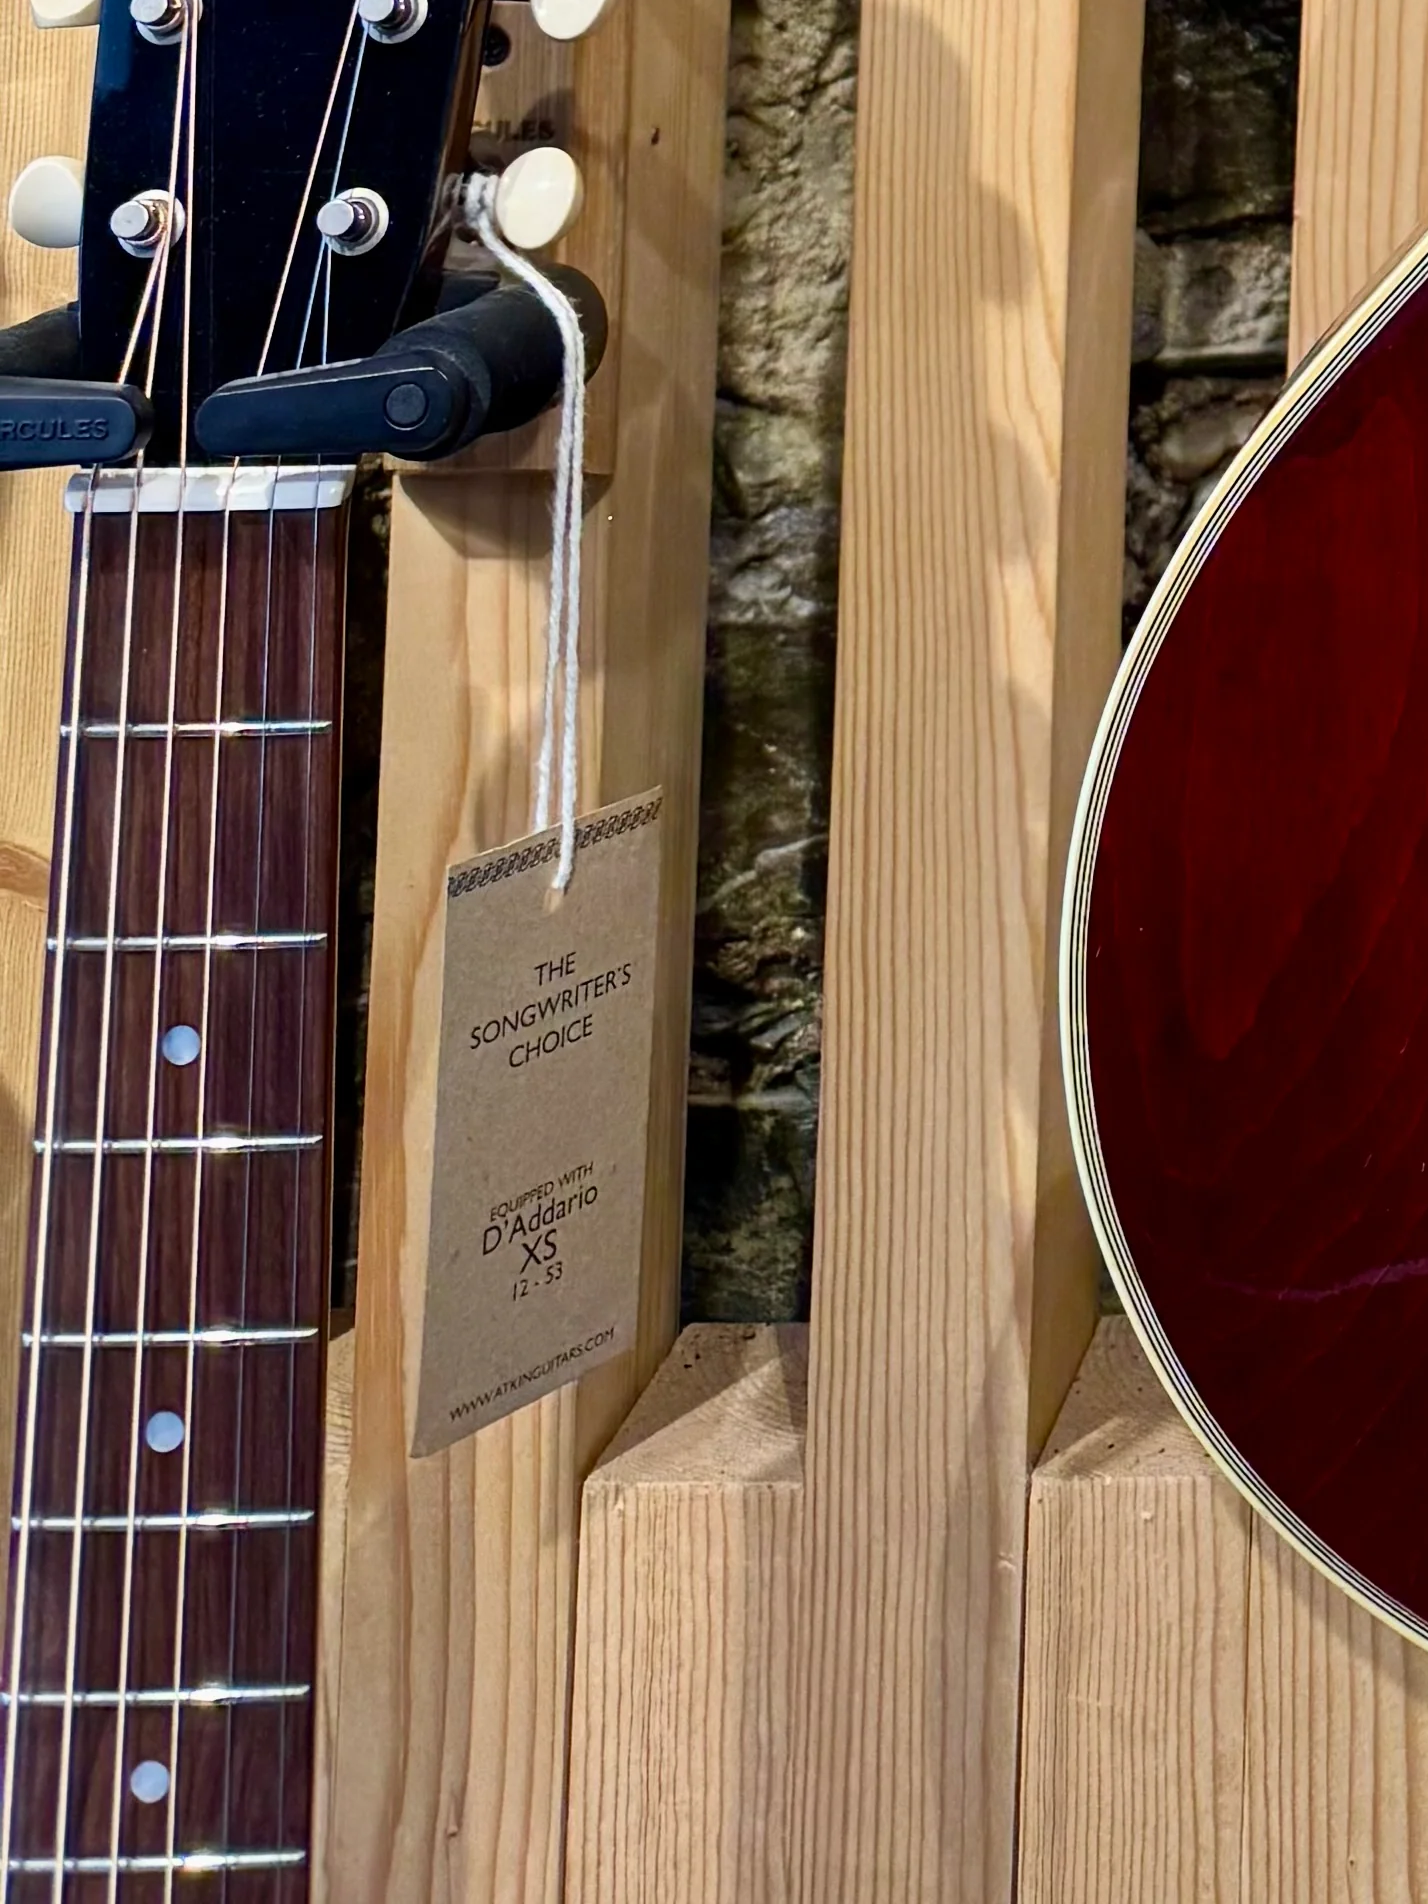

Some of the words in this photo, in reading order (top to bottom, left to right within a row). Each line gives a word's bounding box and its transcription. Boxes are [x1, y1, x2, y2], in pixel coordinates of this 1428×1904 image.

[534, 951, 577, 986] THE
[470, 963, 632, 1050] SONGWRITER'S
[509, 1013, 593, 1068] CHOICE
[490, 1181, 554, 1223] EQUIPPED
[558, 1161, 594, 1189] WITH
[483, 1185, 598, 1256] D'Addario
[520, 1228, 557, 1275] XS
[513, 1279, 529, 1302] 12
[545, 1261, 563, 1285] 53
